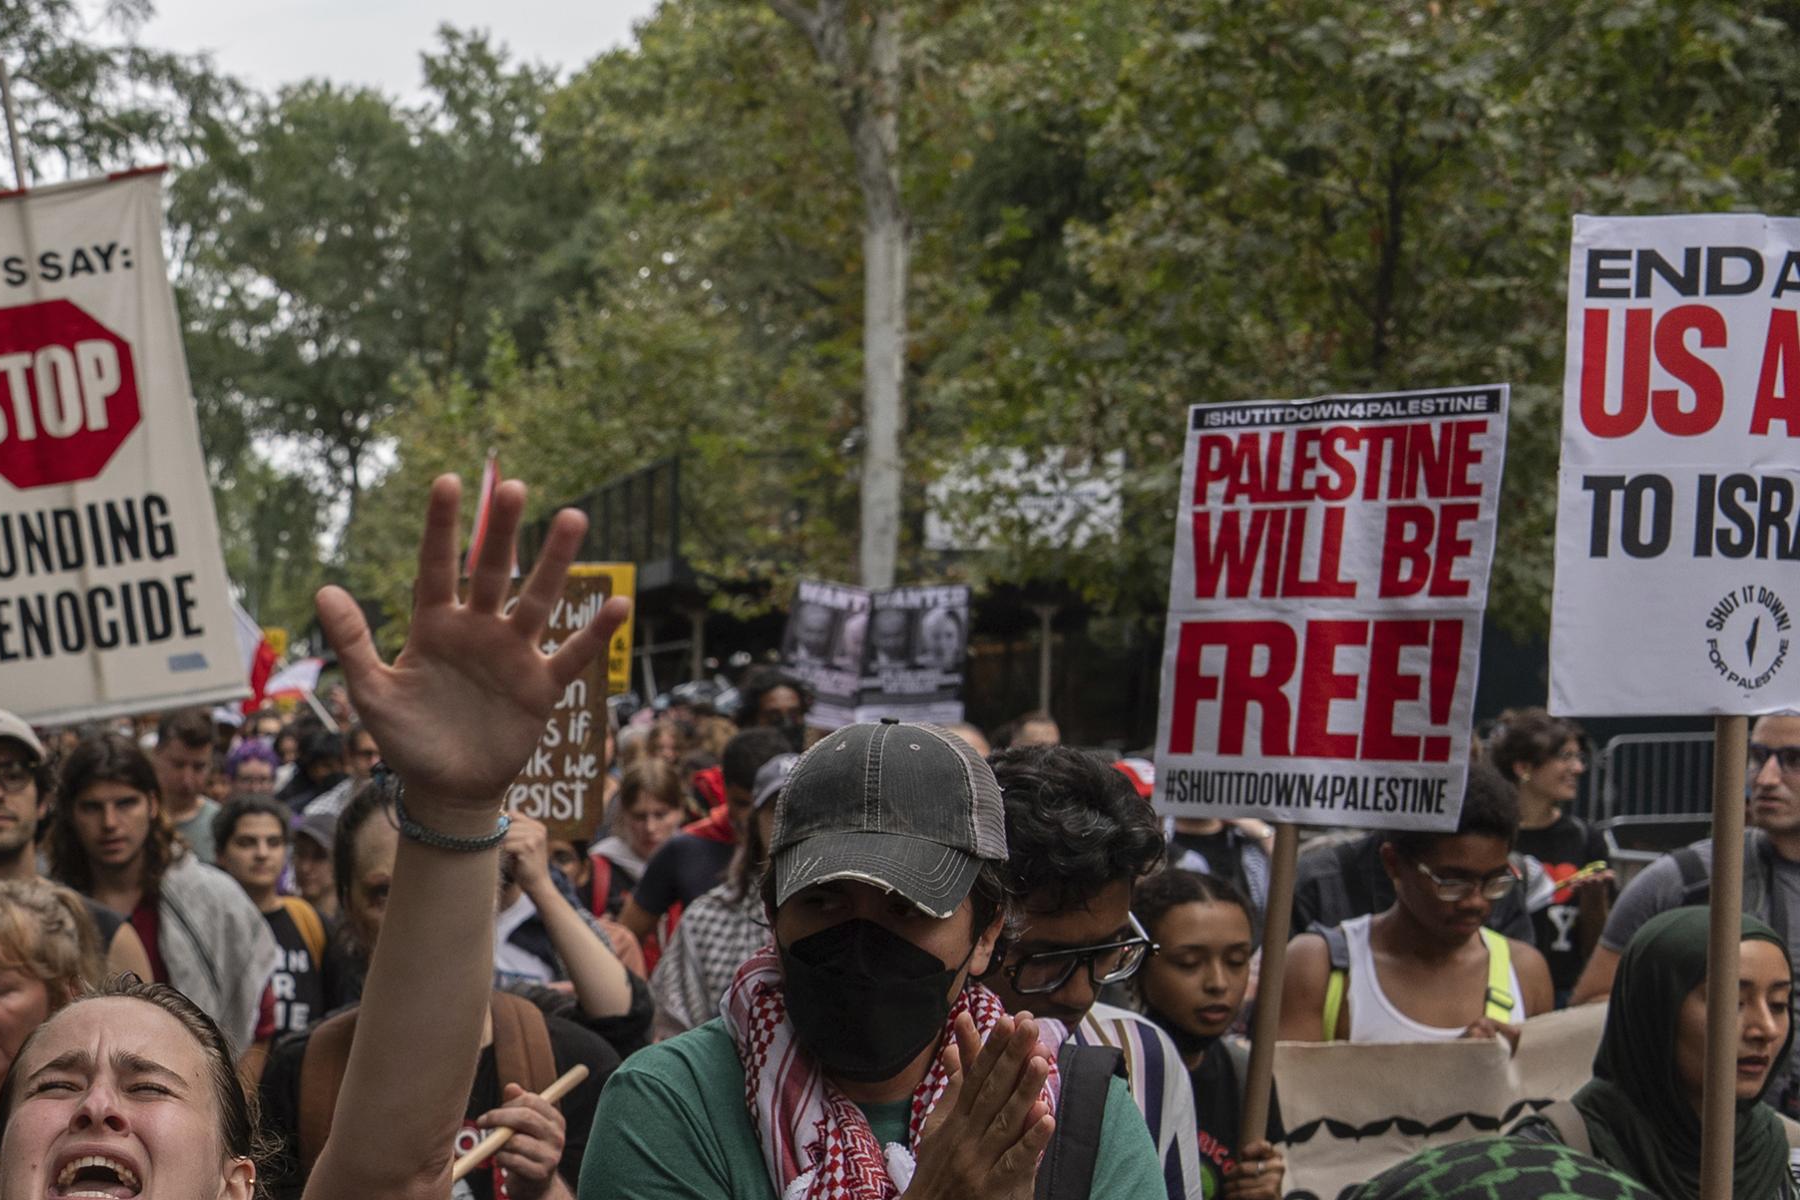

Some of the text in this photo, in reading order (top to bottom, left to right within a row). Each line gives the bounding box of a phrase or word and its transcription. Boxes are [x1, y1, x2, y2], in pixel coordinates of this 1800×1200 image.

[39, 241, 134, 283] SAY:
[1585, 246, 1765, 299] END
[1579, 304, 1728, 439] US
[1191, 419, 1490, 507] PALESTINE
[1582, 473, 1800, 561] TO ISR
[1191, 502, 1481, 600] WILL BE
[1705, 584, 1792, 633] SHUT IT DOWN!
[1706, 637, 1790, 691] FOR PALESTINE
[1167, 619, 1465, 763] FREE!
[567, 710, 593, 744] if
[563, 752, 599, 779] we
[1164, 769, 1449, 815] #SHUTITDOWN4PALESTINE
[507, 780, 588, 821] esist
